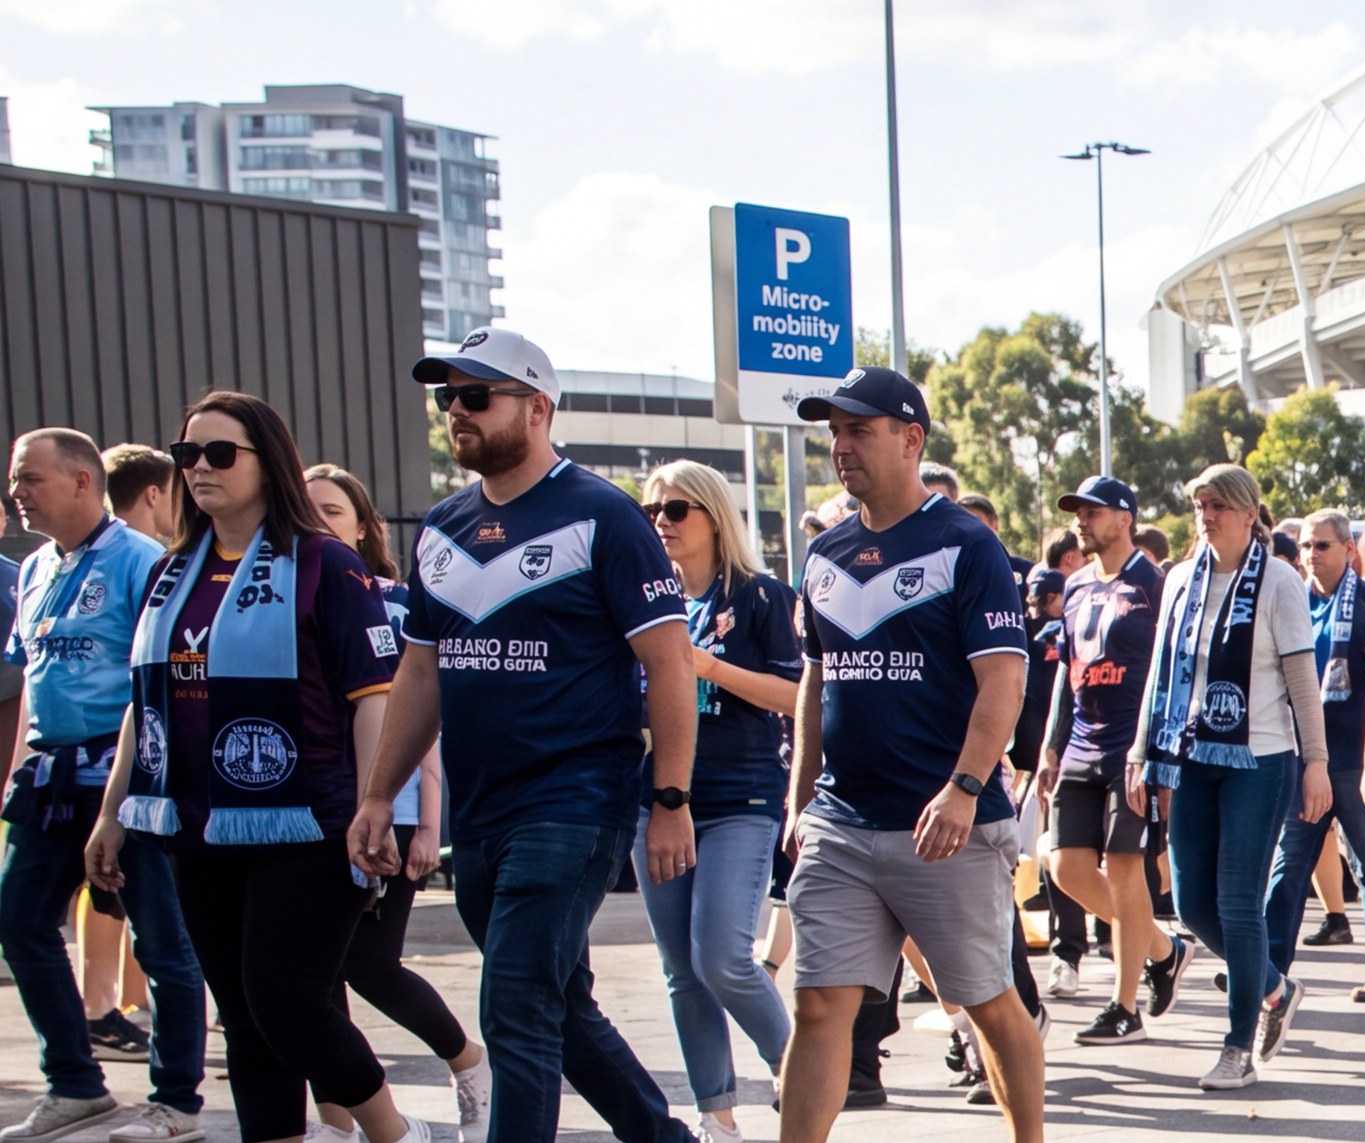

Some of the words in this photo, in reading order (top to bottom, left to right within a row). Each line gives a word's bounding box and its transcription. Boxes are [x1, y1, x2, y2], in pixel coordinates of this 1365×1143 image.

[775, 227, 811, 280] P
[762, 284, 830, 312] Micro-
[771, 342, 823, 362] zone
